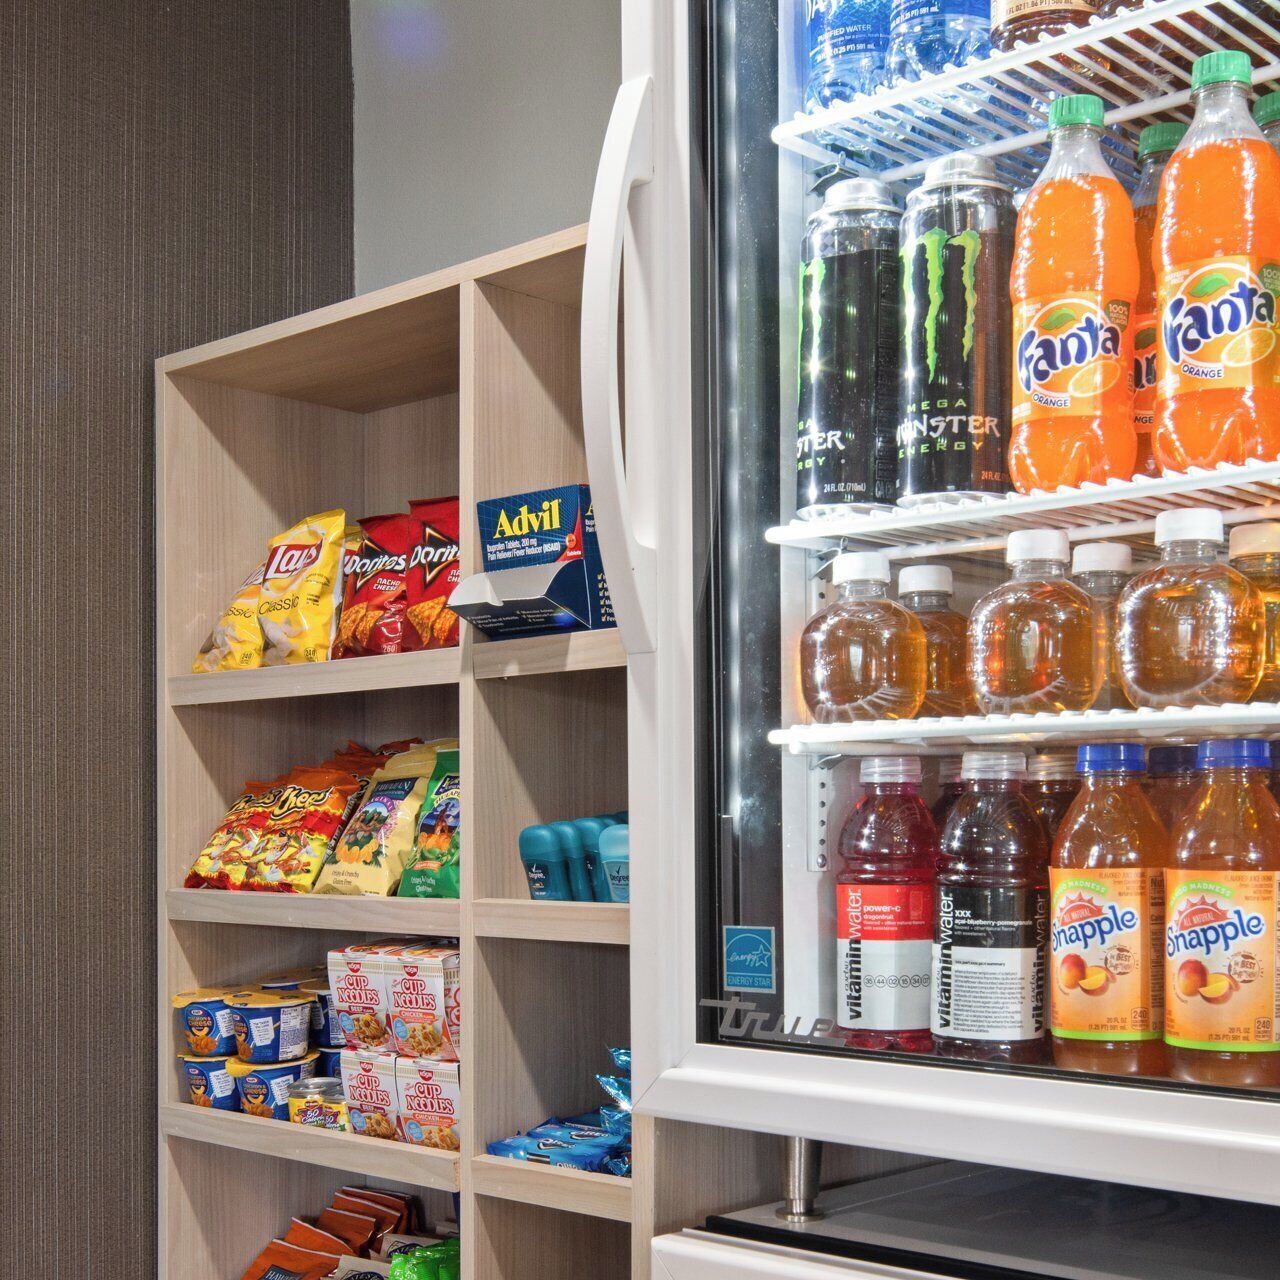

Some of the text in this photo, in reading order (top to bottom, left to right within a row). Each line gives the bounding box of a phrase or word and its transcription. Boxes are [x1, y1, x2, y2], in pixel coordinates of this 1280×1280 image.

[846, 24, 871, 34] WATER
[1108, 304, 1128, 315] 100%
[1182, 364, 1223, 378] ORANGE
[907, 398, 967, 414] MEGA
[1032, 394, 1070, 408] ORANGE
[896, 414, 1001, 447] MONSTER
[898, 442, 984, 460] ENERGY
[824, 483, 830, 492] 24
[494, 499, 560, 539] Advil
[487, 542, 504, 552] Ibuprofen
[522, 538, 530, 547] 200
[530, 538, 538, 547] mg
[488, 552, 496, 561] Pain
[526, 546, 542, 556] Reducer
[346, 554, 406, 574] Doritos
[376, 578, 401, 586] NACHO
[258, 594, 300, 615] Classic
[1068, 881, 1107, 894] MADNESS
[1190, 883, 1232, 897] MADNESS
[864, 904, 901, 912] power-c
[1063, 908, 1090, 922] ALL NATURAL
[1184, 912, 1214, 926] ALL NATURAL
[1052, 905, 1137, 952] Snapple
[1166, 910, 1265, 958] Snapple
[846, 888, 862, 1020] vitaminwater
[938, 890, 954, 1028] vitaminwater
[1116, 952, 1132, 962] BEST
[1240, 960, 1256, 969] BEST
[345, 974, 368, 990] CUP
[402, 979, 426, 994] CUP
[728, 976, 771, 986] ENERGY STAR
[336, 988, 380, 1006] NOODLES
[394, 994, 436, 1010] NOODLES
[699, 996, 847, 1047] true
[1133, 1010, 1147, 1019] 240
[1256, 1020, 1270, 1030] 240
[356, 1074, 380, 1088] CUP
[348, 1088, 390, 1106] NOODLES
[414, 1084, 442, 1098] CUP
[406, 1098, 454, 1114] NOODLES
[414, 1114, 440, 1122] CHICKEN
